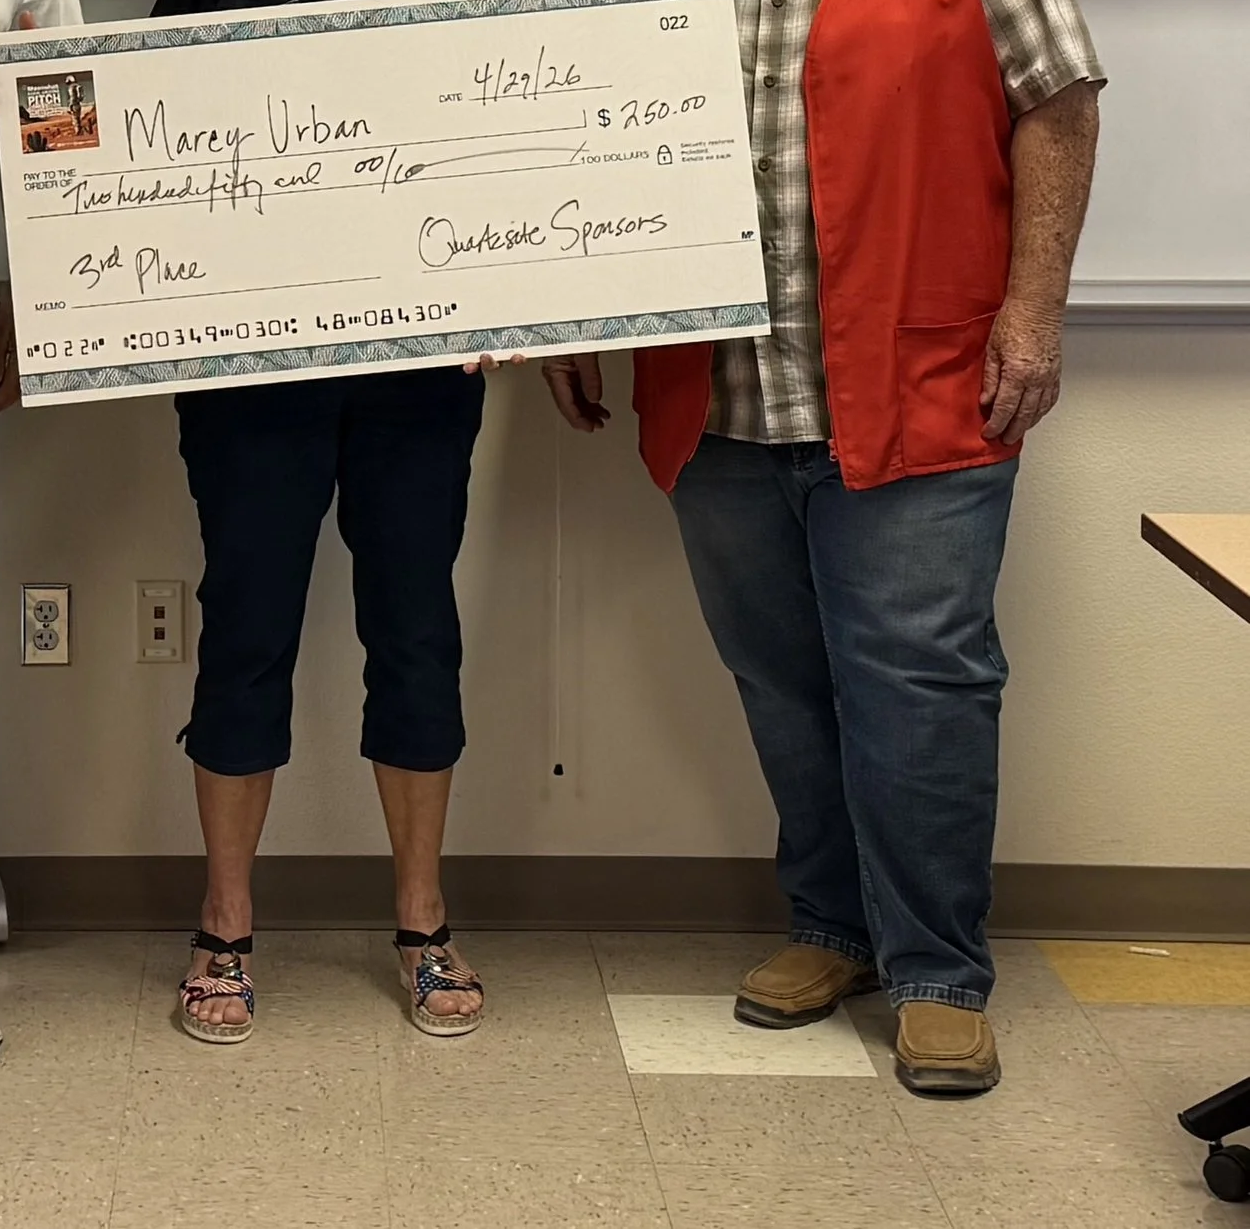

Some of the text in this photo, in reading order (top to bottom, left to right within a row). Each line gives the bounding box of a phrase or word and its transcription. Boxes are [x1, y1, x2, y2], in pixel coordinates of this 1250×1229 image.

[659, 15, 689, 31] 022
[474, 45, 580, 106] 4/29/26
[28, 93, 61, 107] PITCH
[439, 92, 463, 103] DATE
[598, 108, 611, 128] $
[621, 94, 706, 130] 250.00
[267, 94, 371, 153] Urban
[580, 149, 650, 164] 100 DOLLARS
[23, 169, 77, 182] PAY TO THE
[24, 179, 72, 191] ORDER OF
[551, 199, 667, 256] Sponsors
[70, 245, 206, 294] 3rd Place
[35, 301, 66, 310] MEMO
